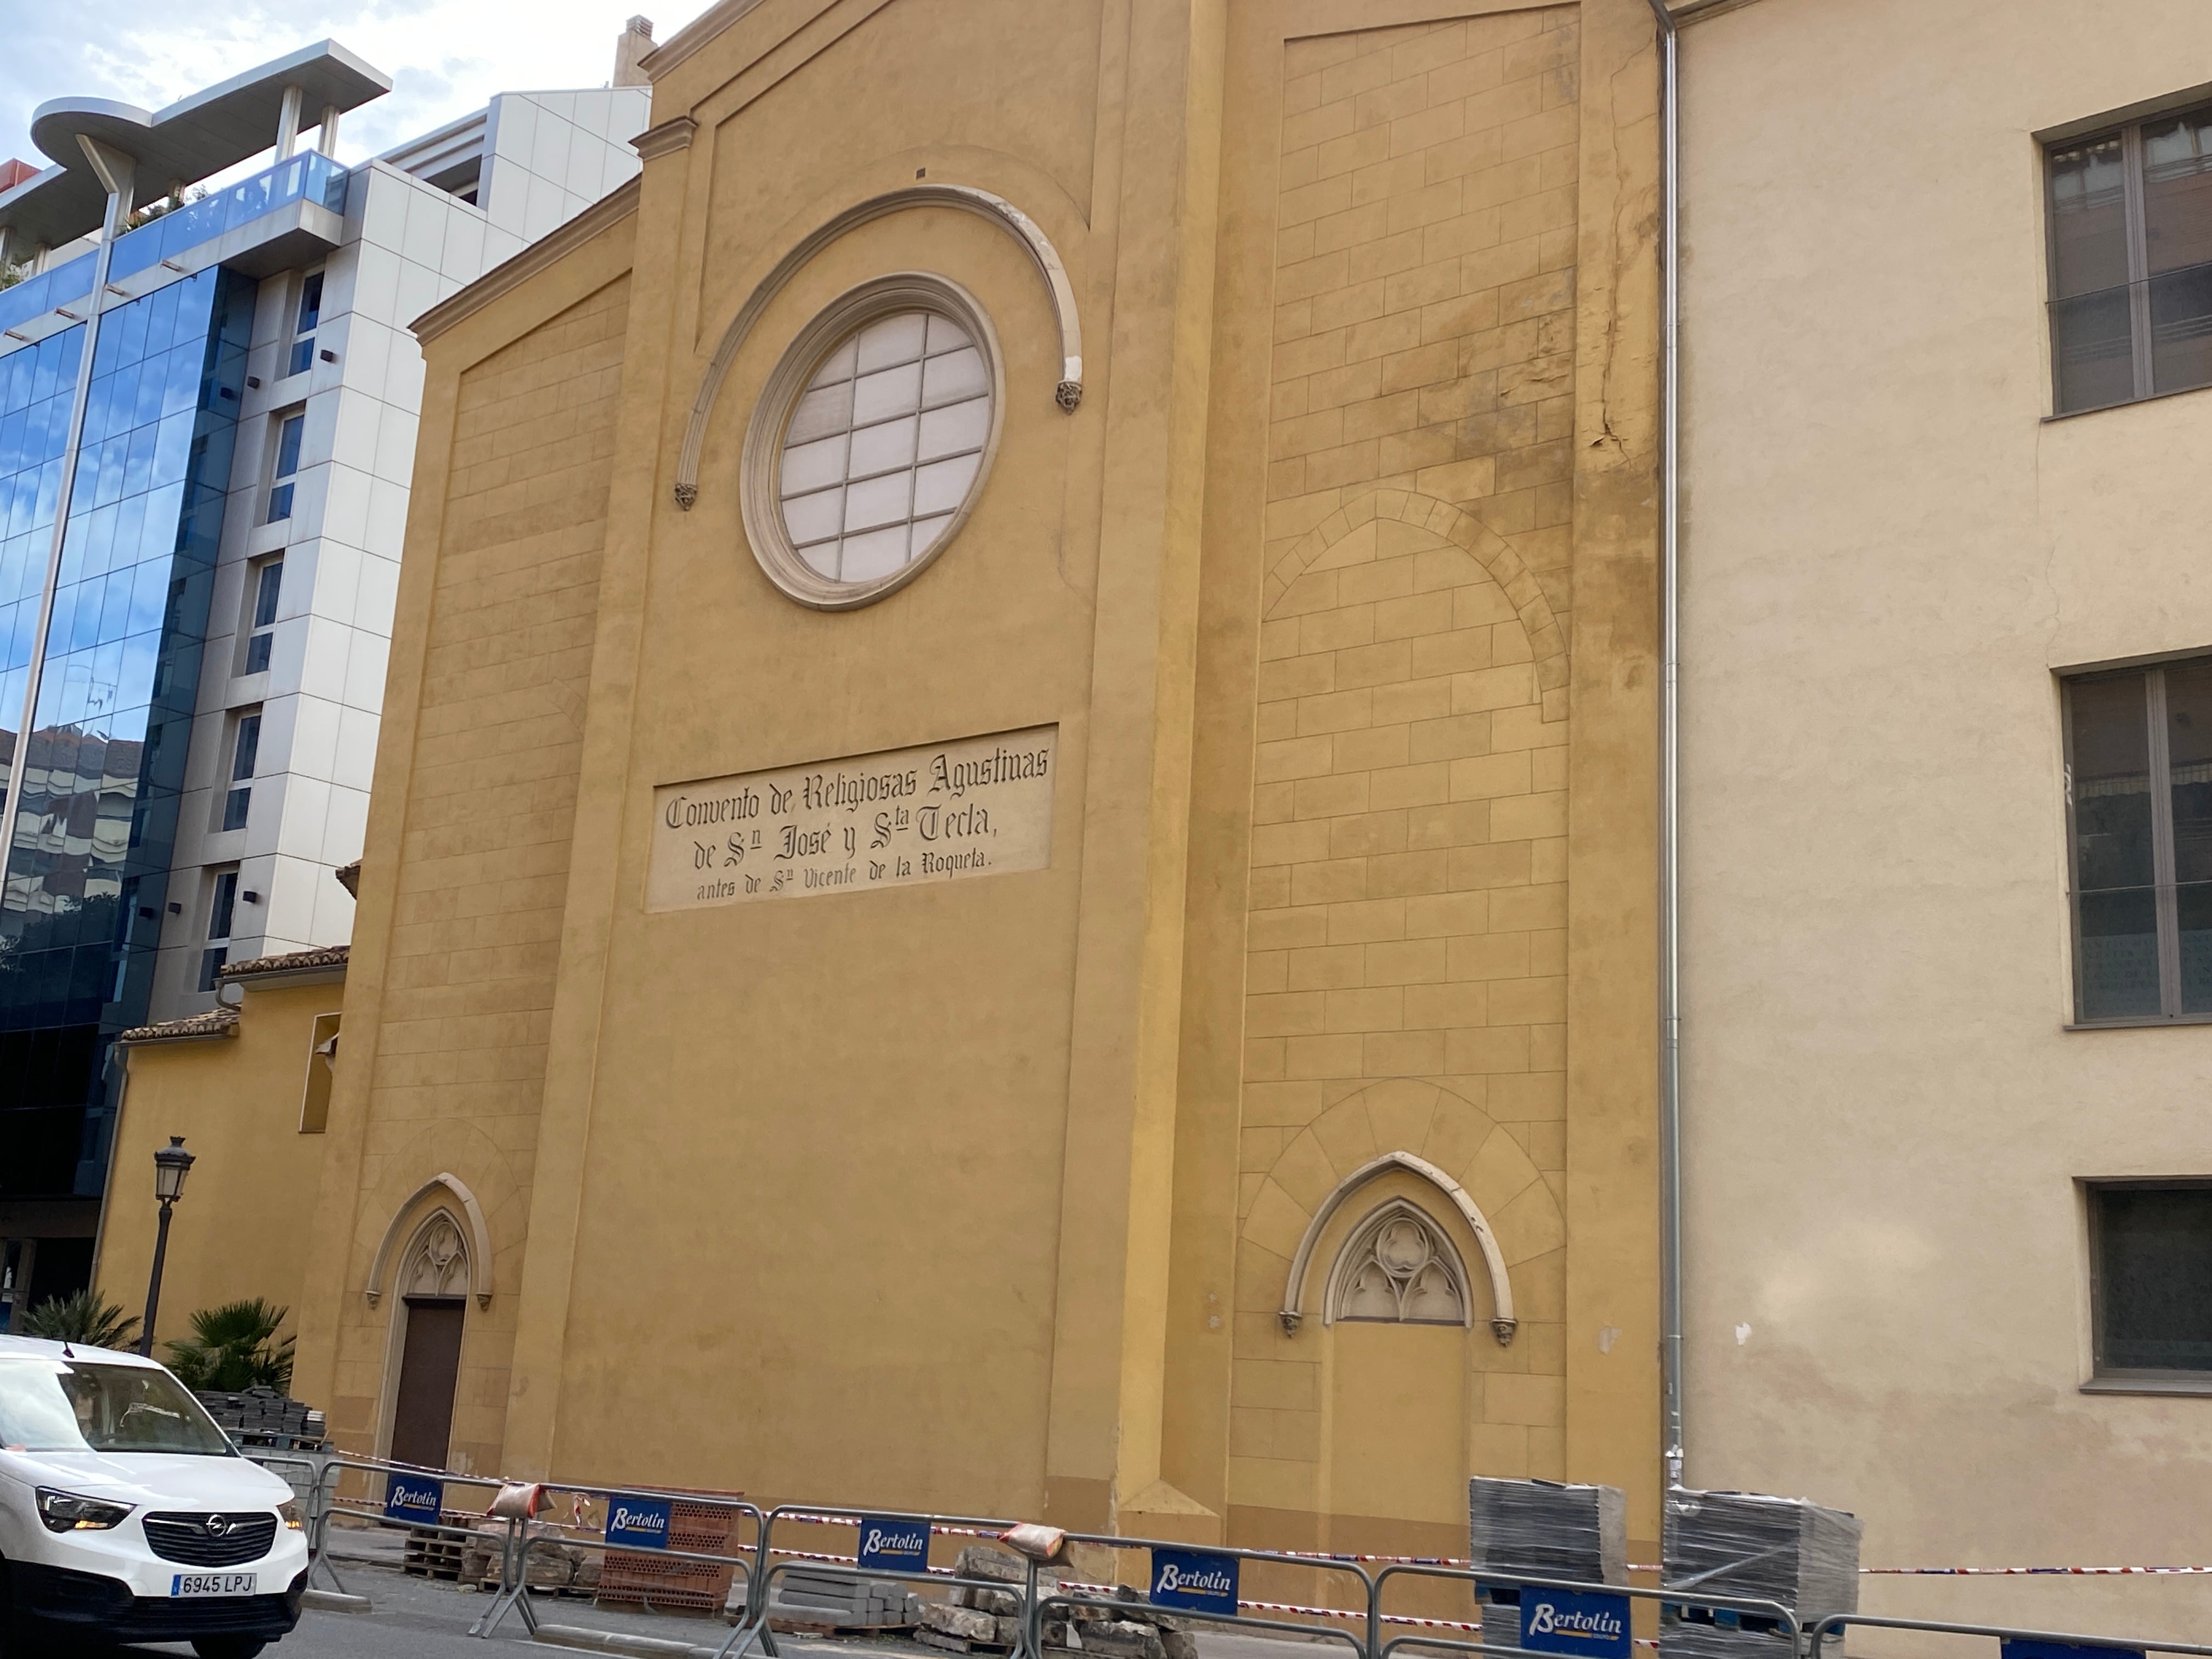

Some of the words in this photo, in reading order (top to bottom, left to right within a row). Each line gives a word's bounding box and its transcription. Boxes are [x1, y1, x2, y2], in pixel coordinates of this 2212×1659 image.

[665, 786, 760, 829] Convento
[769, 783, 793, 815] de
[803, 769, 917, 812] Religiosas
[927, 747, 1049, 800] Agustinas
[694, 840, 716, 870] de
[774, 823, 832, 861] José
[843, 826, 856, 860] y
[915, 803, 997, 841] Tecla,
[697, 878, 736, 900] antes
[744, 873, 761, 894] de
[804, 862, 857, 888] Vicente
[869, 860, 886, 880] de
[895, 855, 911, 878] la
[922, 847, 992, 878] Roqueta.
[183, 1577, 221, 1593] 6945
[224, 1576, 252, 1592] LPJ
[1156, 1564, 1231, 1594] Bertolín
[1529, 1604, 1622, 1637] Bertolín
